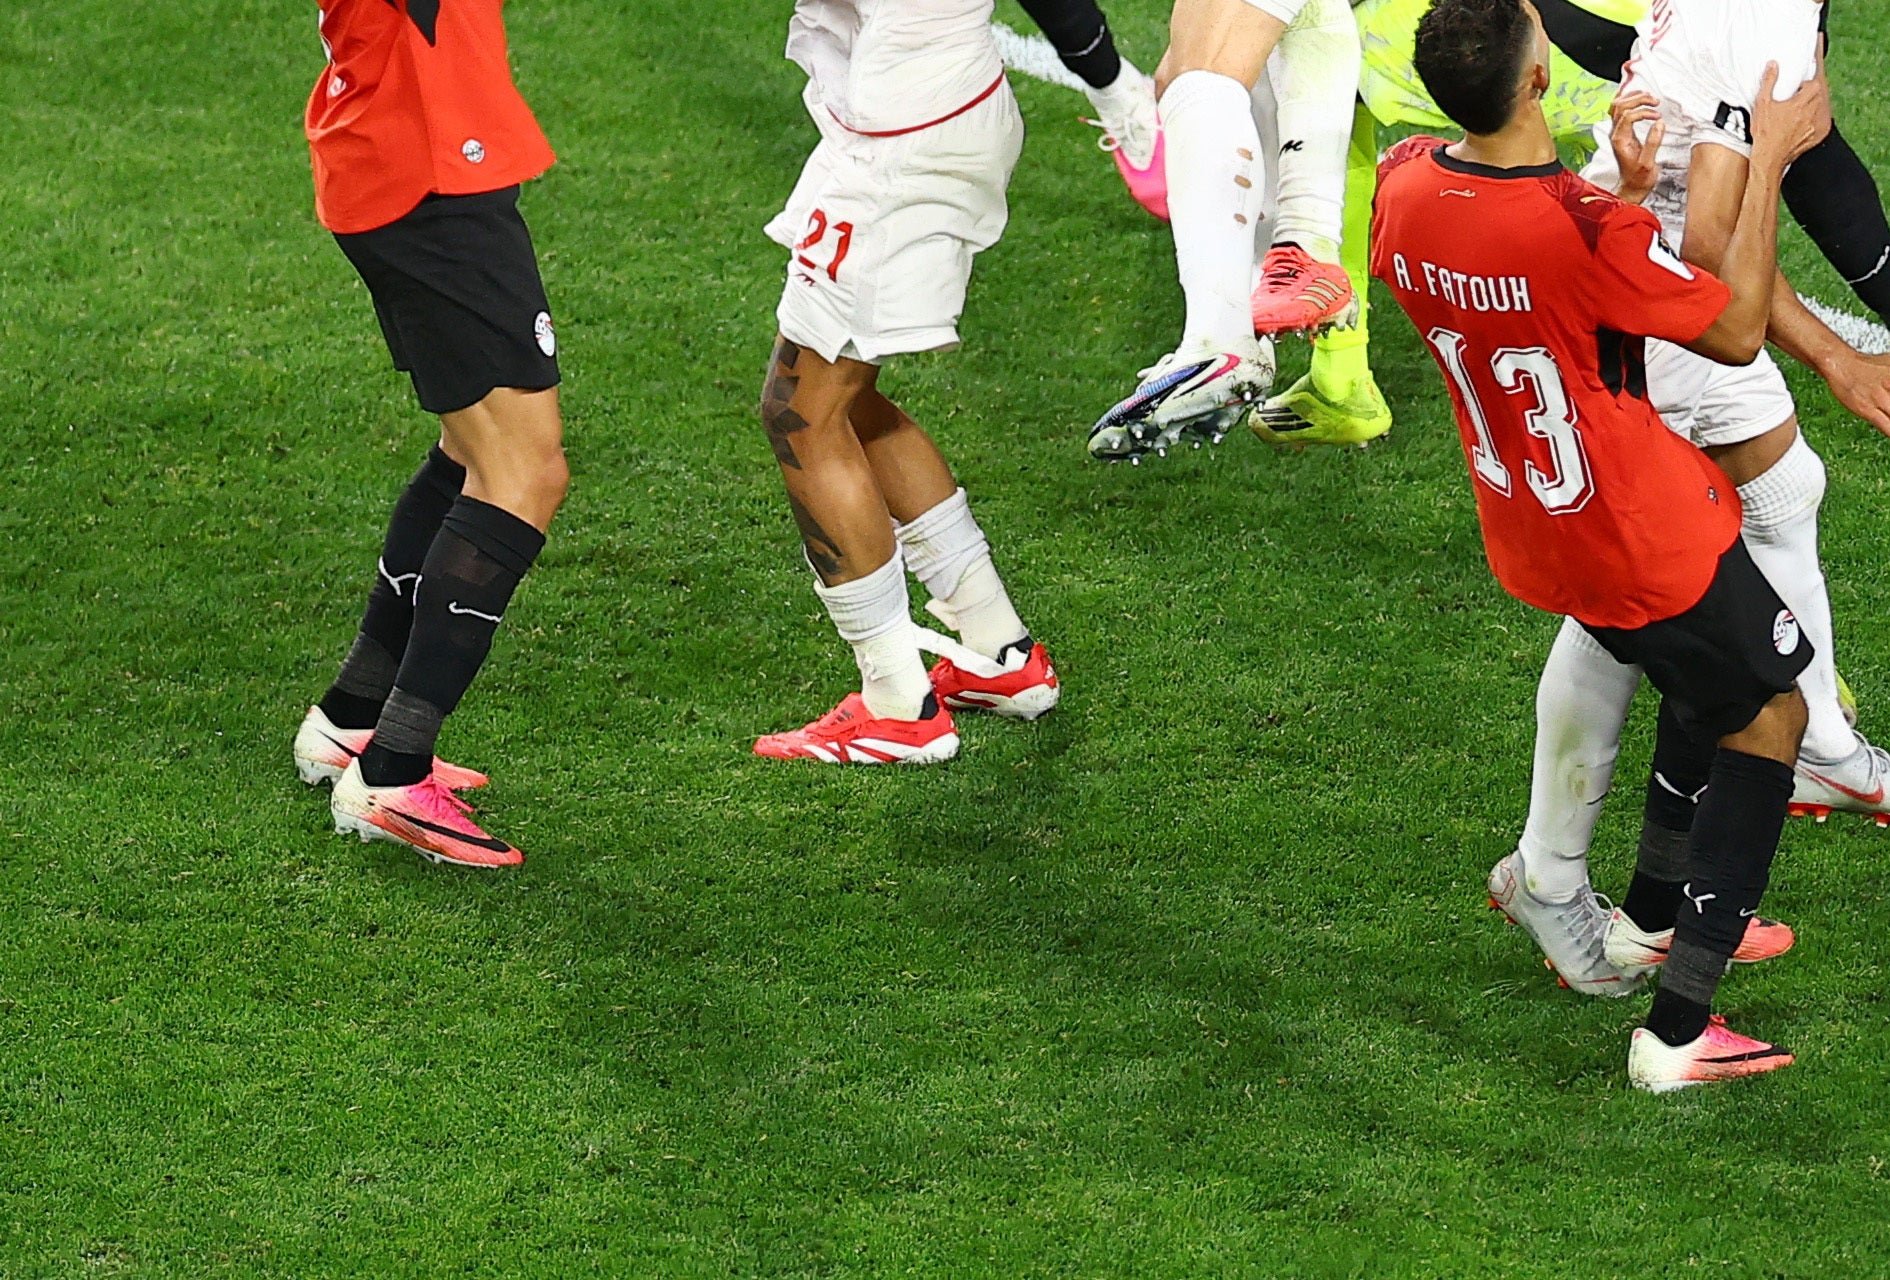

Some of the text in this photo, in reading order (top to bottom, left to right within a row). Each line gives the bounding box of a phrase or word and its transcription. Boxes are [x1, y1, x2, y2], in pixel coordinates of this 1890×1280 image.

[794, 207, 854, 284] 21
[1393, 252, 1533, 313] A. FATOUH
[1427, 326, 1596, 516] 13
